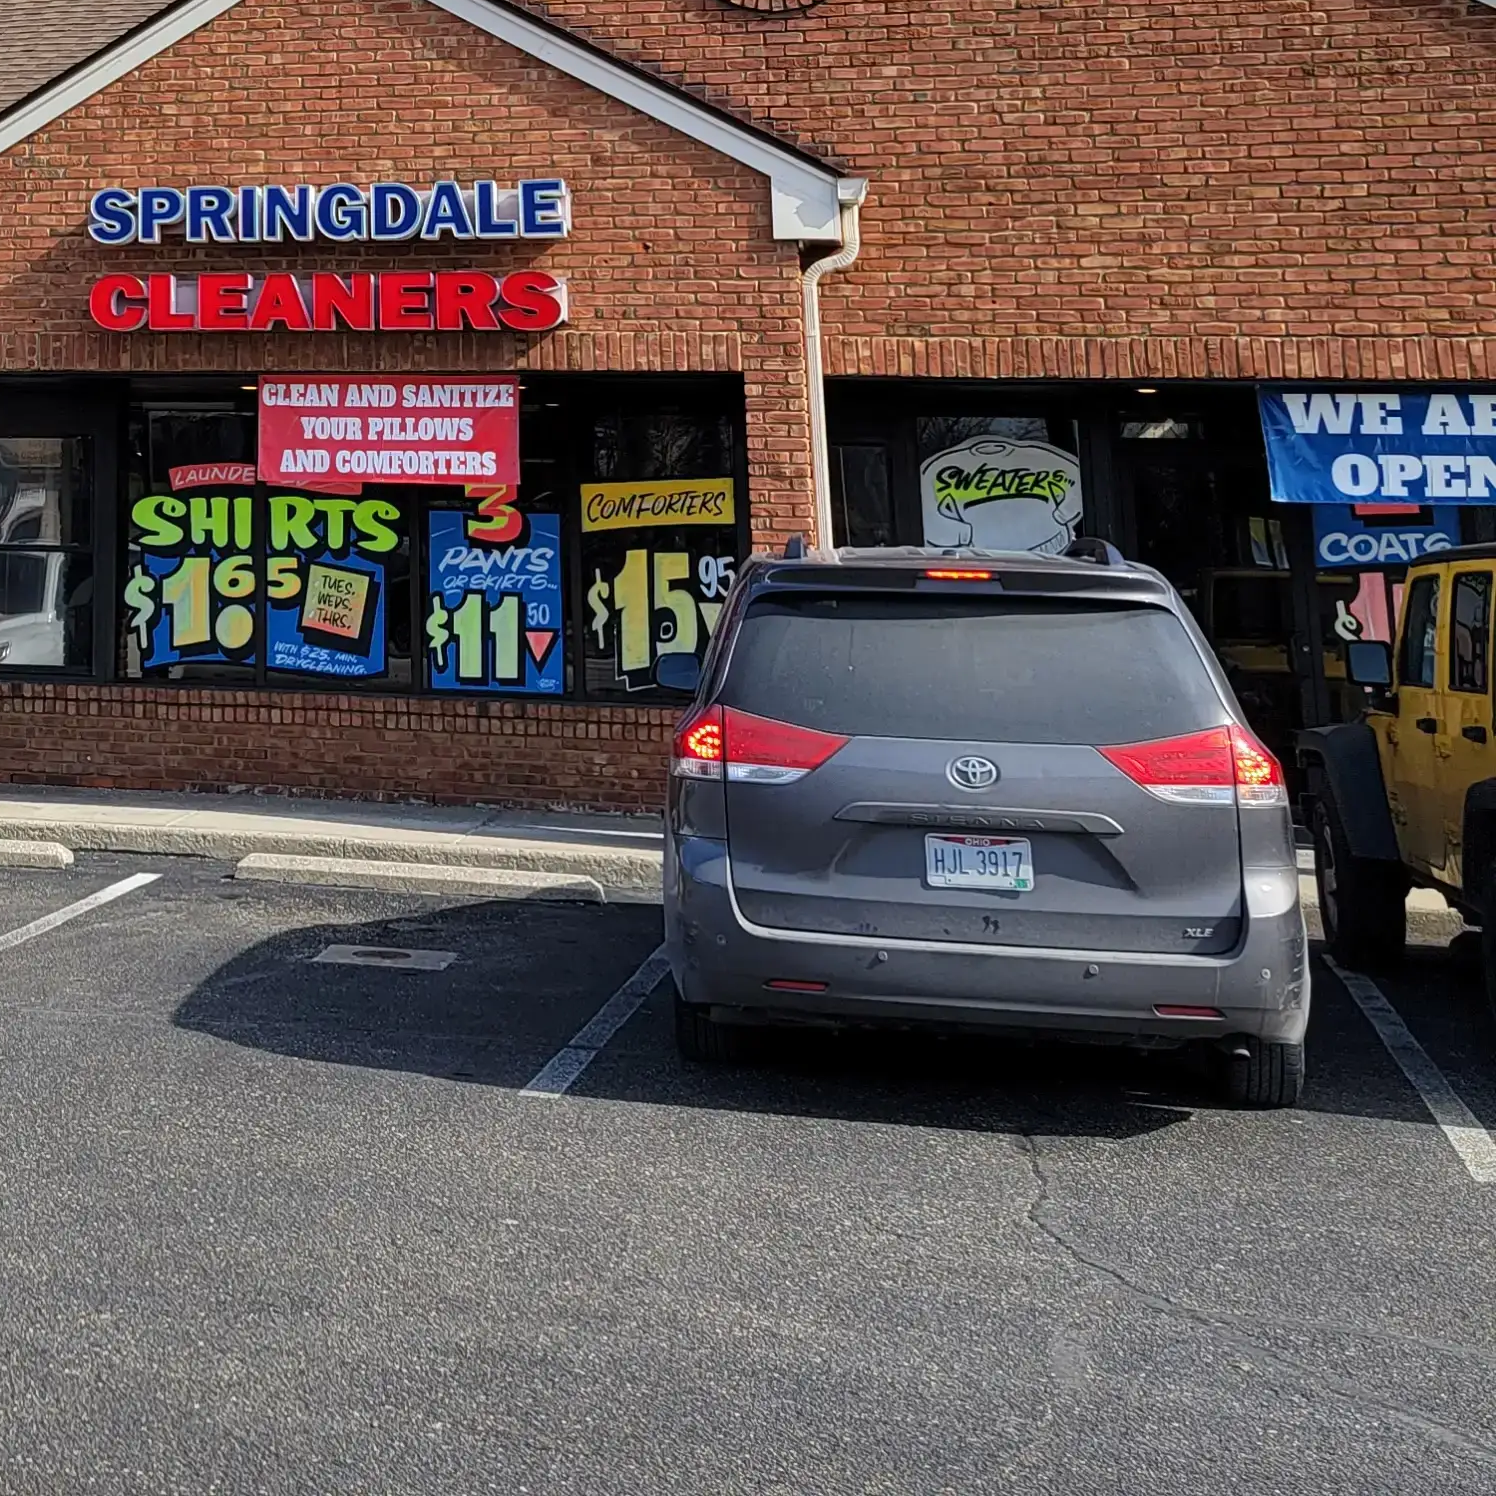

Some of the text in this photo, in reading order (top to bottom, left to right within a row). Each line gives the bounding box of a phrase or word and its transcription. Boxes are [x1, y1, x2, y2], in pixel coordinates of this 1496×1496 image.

[88, 179, 570, 245] SPRINGDALE
[89, 270, 566, 331] CLEANERS
[262, 384, 514, 408] CLEAN AND SANITIZE
[1282, 393, 1403, 435] WE
[300, 417, 473, 441] YOUR PILLOWS
[279, 449, 497, 475] AND COMFORTERS
[465, 484, 523, 542] 3
[587, 490, 726, 523] COMFORTERS
[131, 495, 401, 553] SHIRTS
[438, 546, 555, 574] PANTS
[322, 575, 356, 596] TUES.
[443, 574, 468, 590] OR
[527, 602, 550, 626] 50
[274, 641, 297, 654] WITH
[909, 812, 1046, 830] SIENNA
[964, 837, 991, 847] OHIO
[934, 847, 1023, 878] HJL 3917
[1184, 927, 1215, 938] XLE
